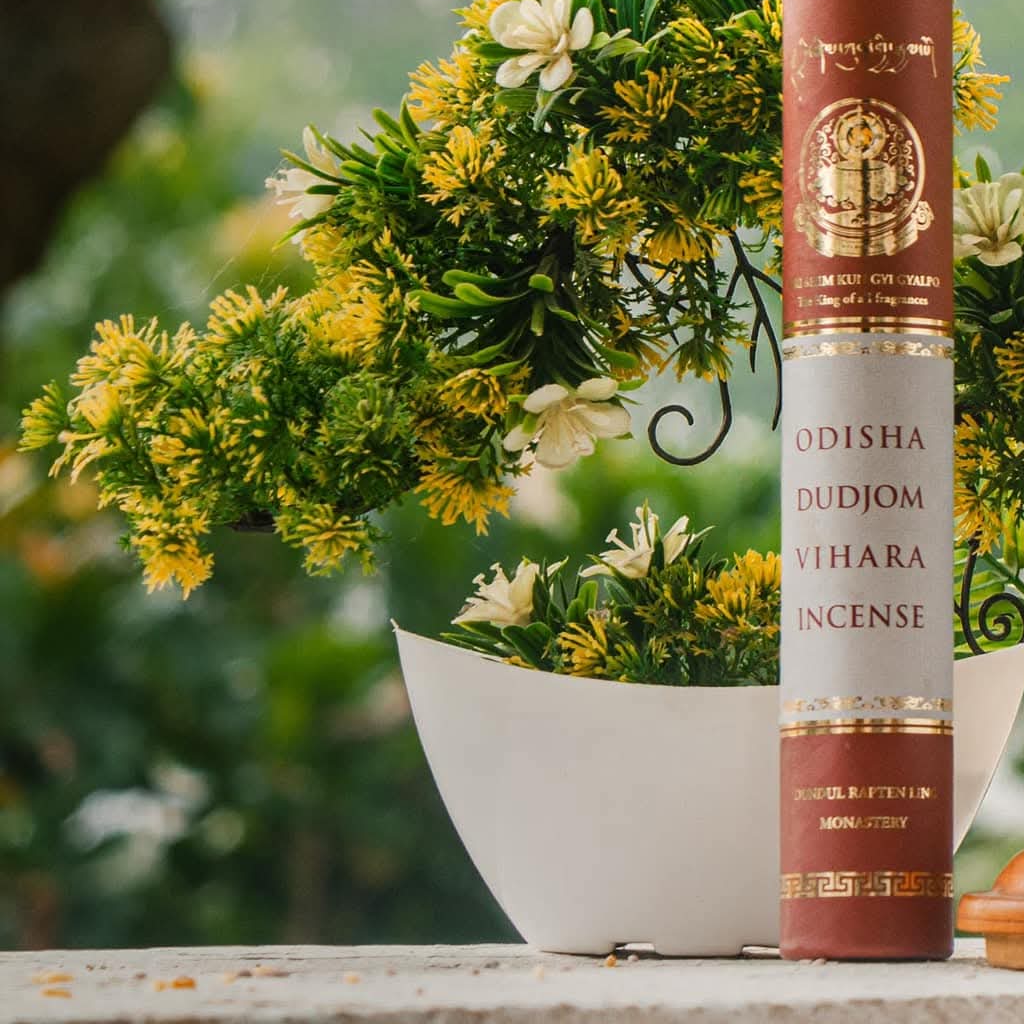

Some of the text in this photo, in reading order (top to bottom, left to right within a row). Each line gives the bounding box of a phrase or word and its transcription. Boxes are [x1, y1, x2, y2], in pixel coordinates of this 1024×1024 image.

[870, 273, 894, 285] GYI
[897, 274, 941, 288] GYALPO
[842, 292, 856, 304] of
[796, 425, 926, 452] ODISHA
[797, 484, 925, 515] DUDJOM
[795, 544, 926, 570] VIHARA
[798, 604, 925, 631] INCENSE
[848, 786, 907, 800] RAPTEN
[819, 816, 908, 831] MONASTERY
